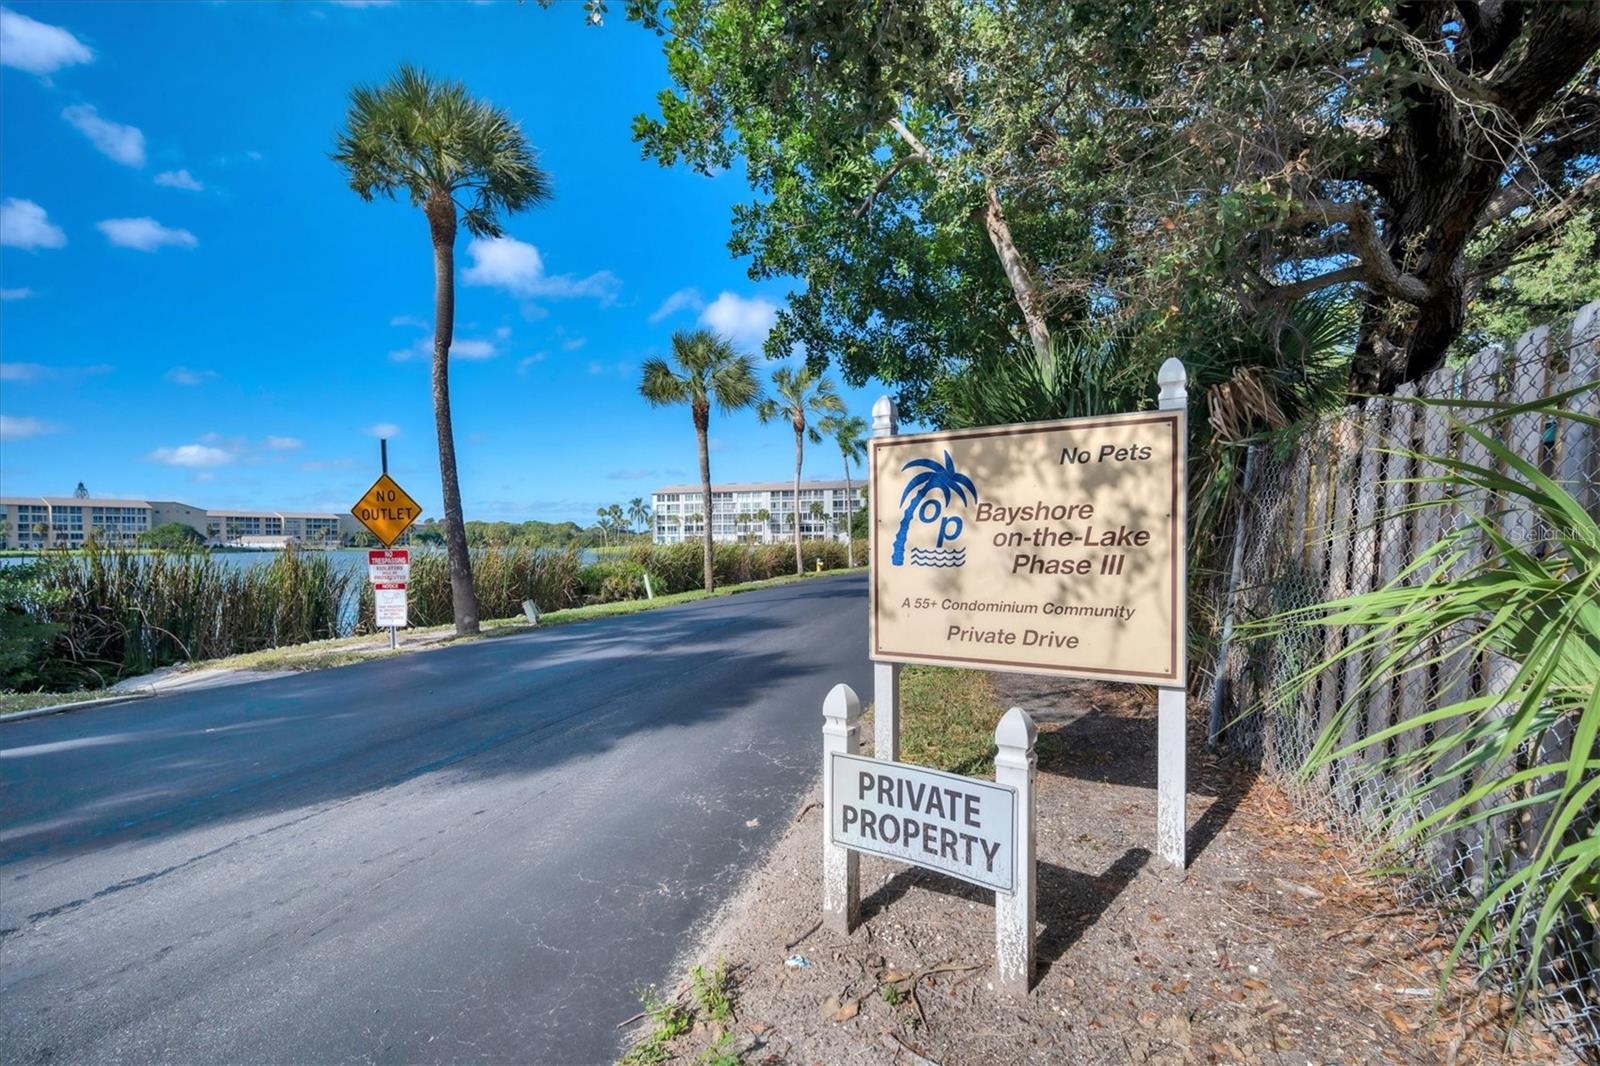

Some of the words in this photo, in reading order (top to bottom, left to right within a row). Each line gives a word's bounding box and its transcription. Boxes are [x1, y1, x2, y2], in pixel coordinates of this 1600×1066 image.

[1059, 447, 1091, 465] No
[1098, 443, 1152, 463] Pets
[376, 490, 396, 502] NO
[361, 507, 412, 521] OUTLET
[975, 501, 1094, 526] Bayshore
[993, 526, 1151, 547] on-the-Lake
[1012, 553, 1091, 575] Phase
[1099, 554, 1125, 575] III
[901, 597, 911, 609] A
[914, 597, 938, 610] 55+
[941, 598, 1038, 614] Condominium
[1042, 602, 1136, 621] Community
[947, 625, 1016, 645] Private
[1022, 629, 1079, 649] Drive
[859, 771, 981, 828] PRIVATE
[842, 804, 1001, 873] PROPERTY
